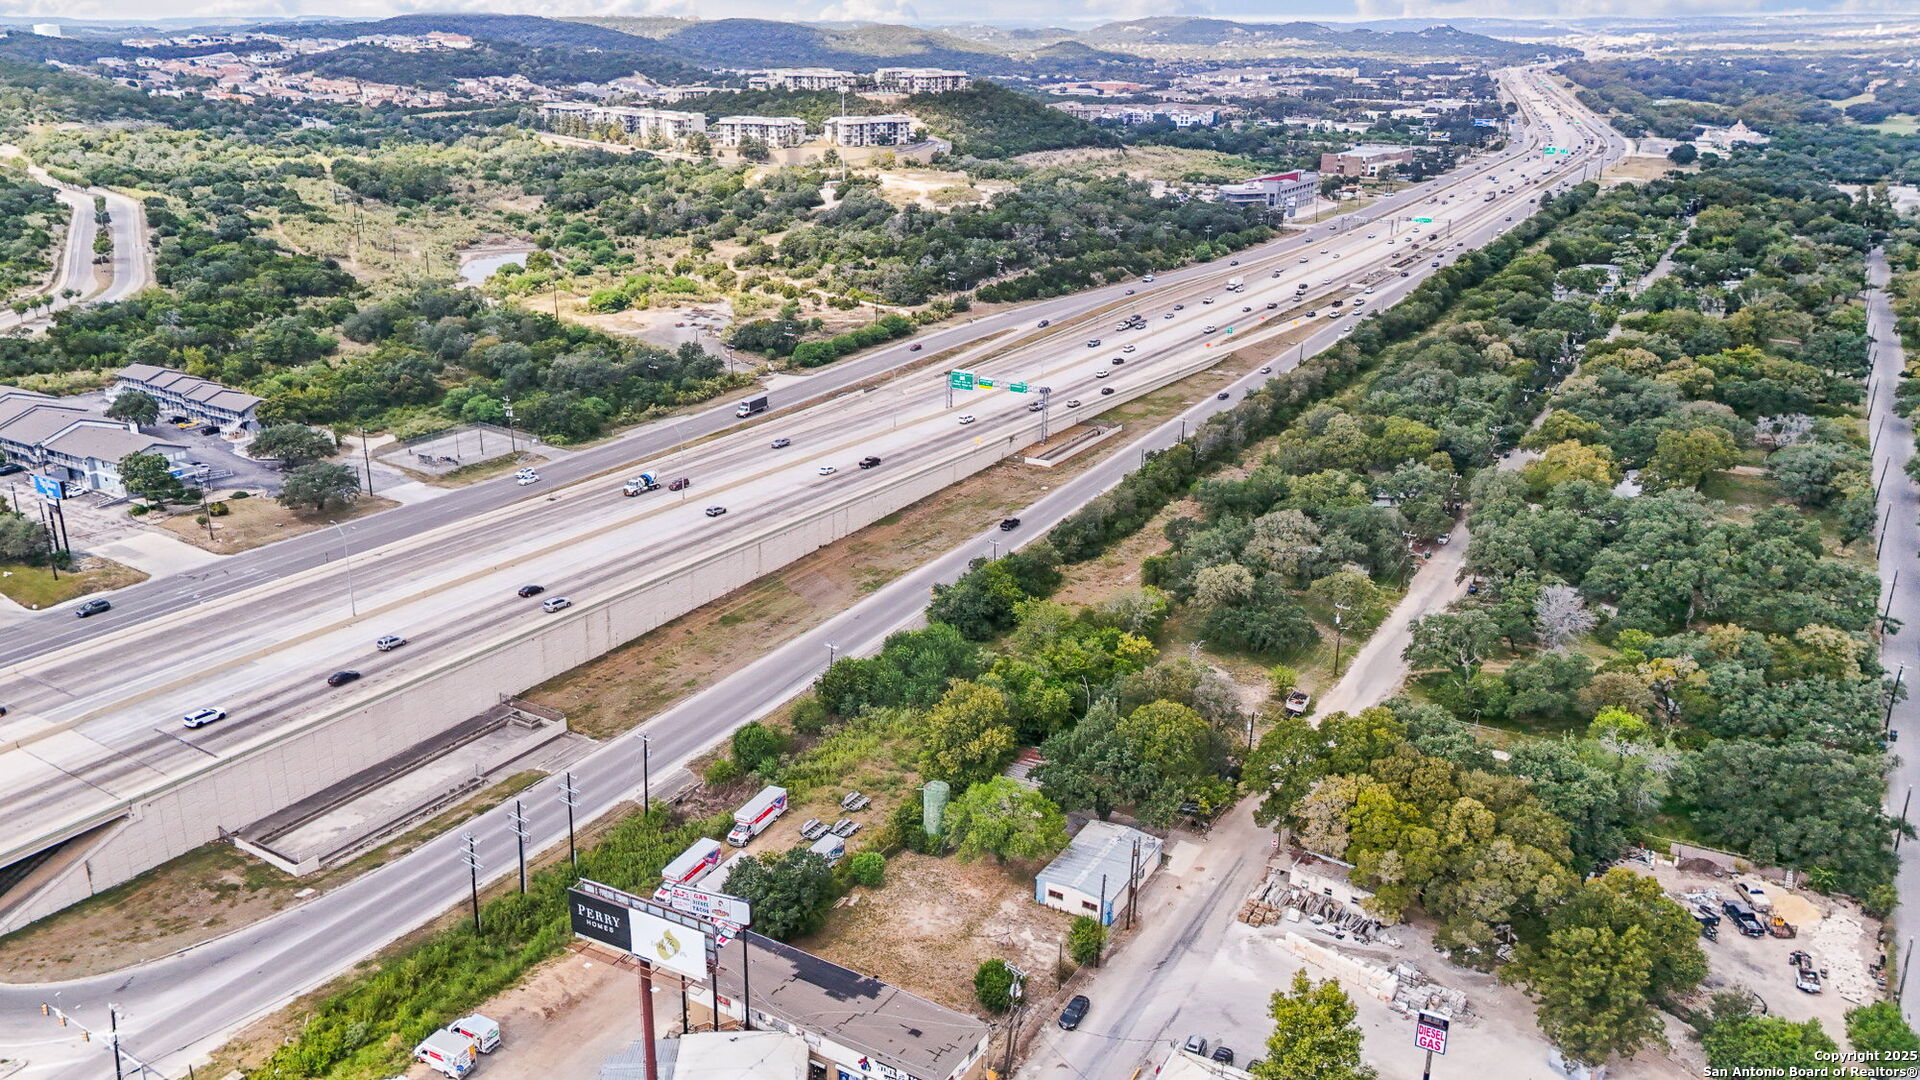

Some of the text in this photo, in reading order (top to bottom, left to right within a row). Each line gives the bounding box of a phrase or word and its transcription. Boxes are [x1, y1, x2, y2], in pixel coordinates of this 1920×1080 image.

[692, 899, 710, 908] DIESEL
[693, 893, 708, 901] GAS
[577, 903, 620, 928] PERRY
[692, 905, 710, 914] TACOS
[586, 919, 614, 933] HOMES
[1418, 1025, 1444, 1041] DIESEL
[1419, 1036, 1441, 1050] GAS
